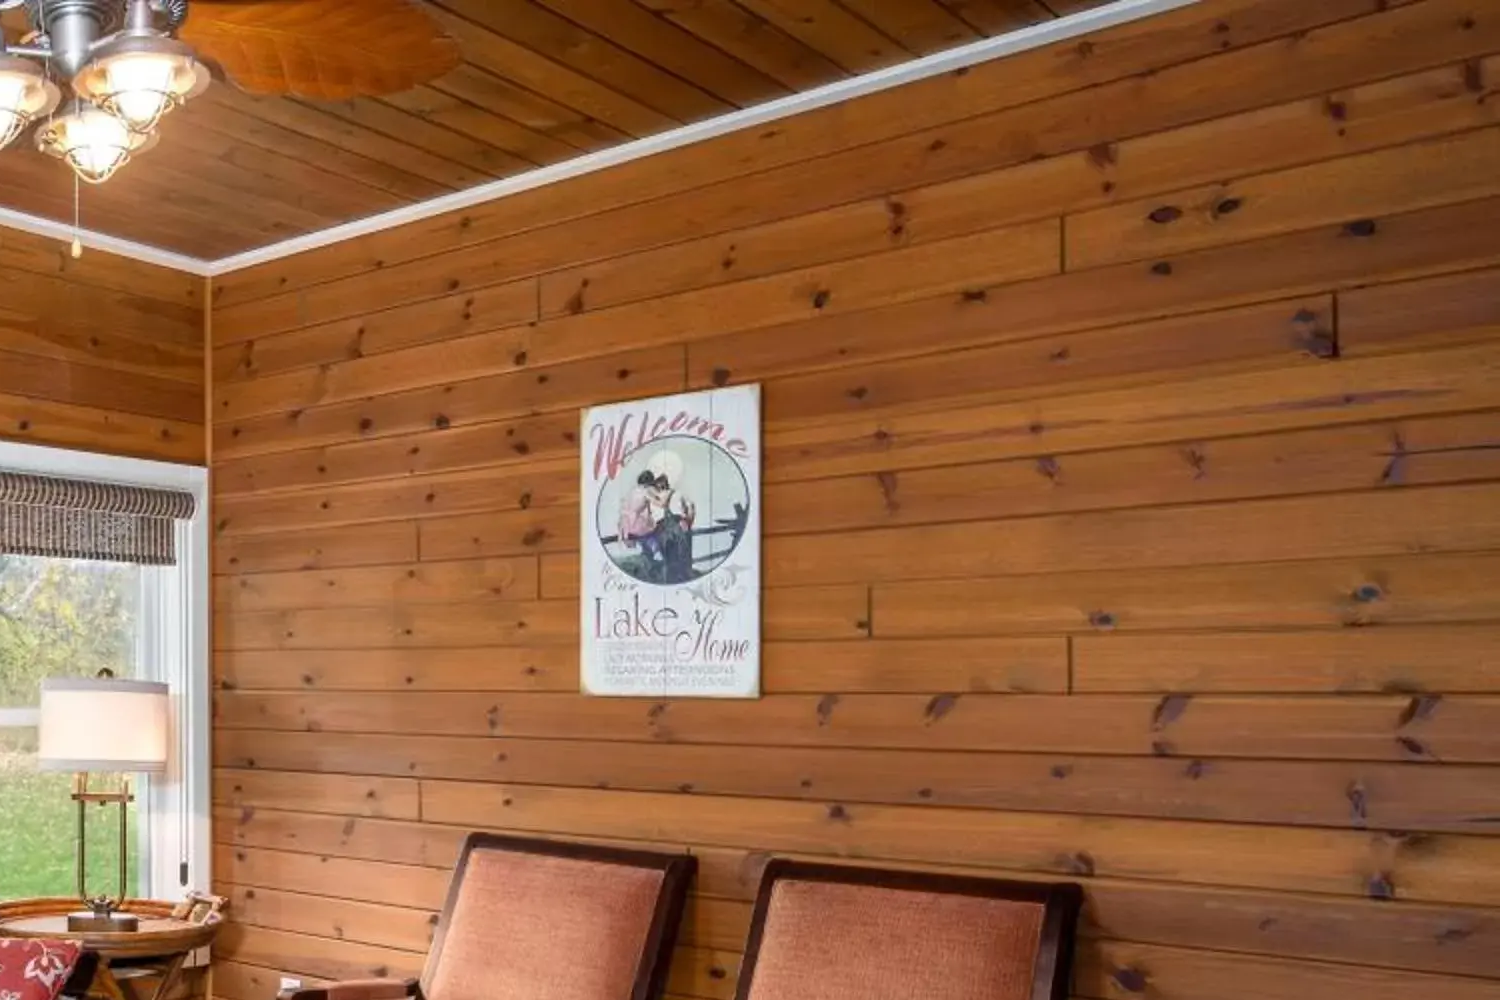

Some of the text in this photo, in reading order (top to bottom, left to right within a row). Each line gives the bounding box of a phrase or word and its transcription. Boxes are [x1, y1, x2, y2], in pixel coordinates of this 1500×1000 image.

[590, 411, 750, 480] Welcome
[594, 592, 750, 662] Lake Home
